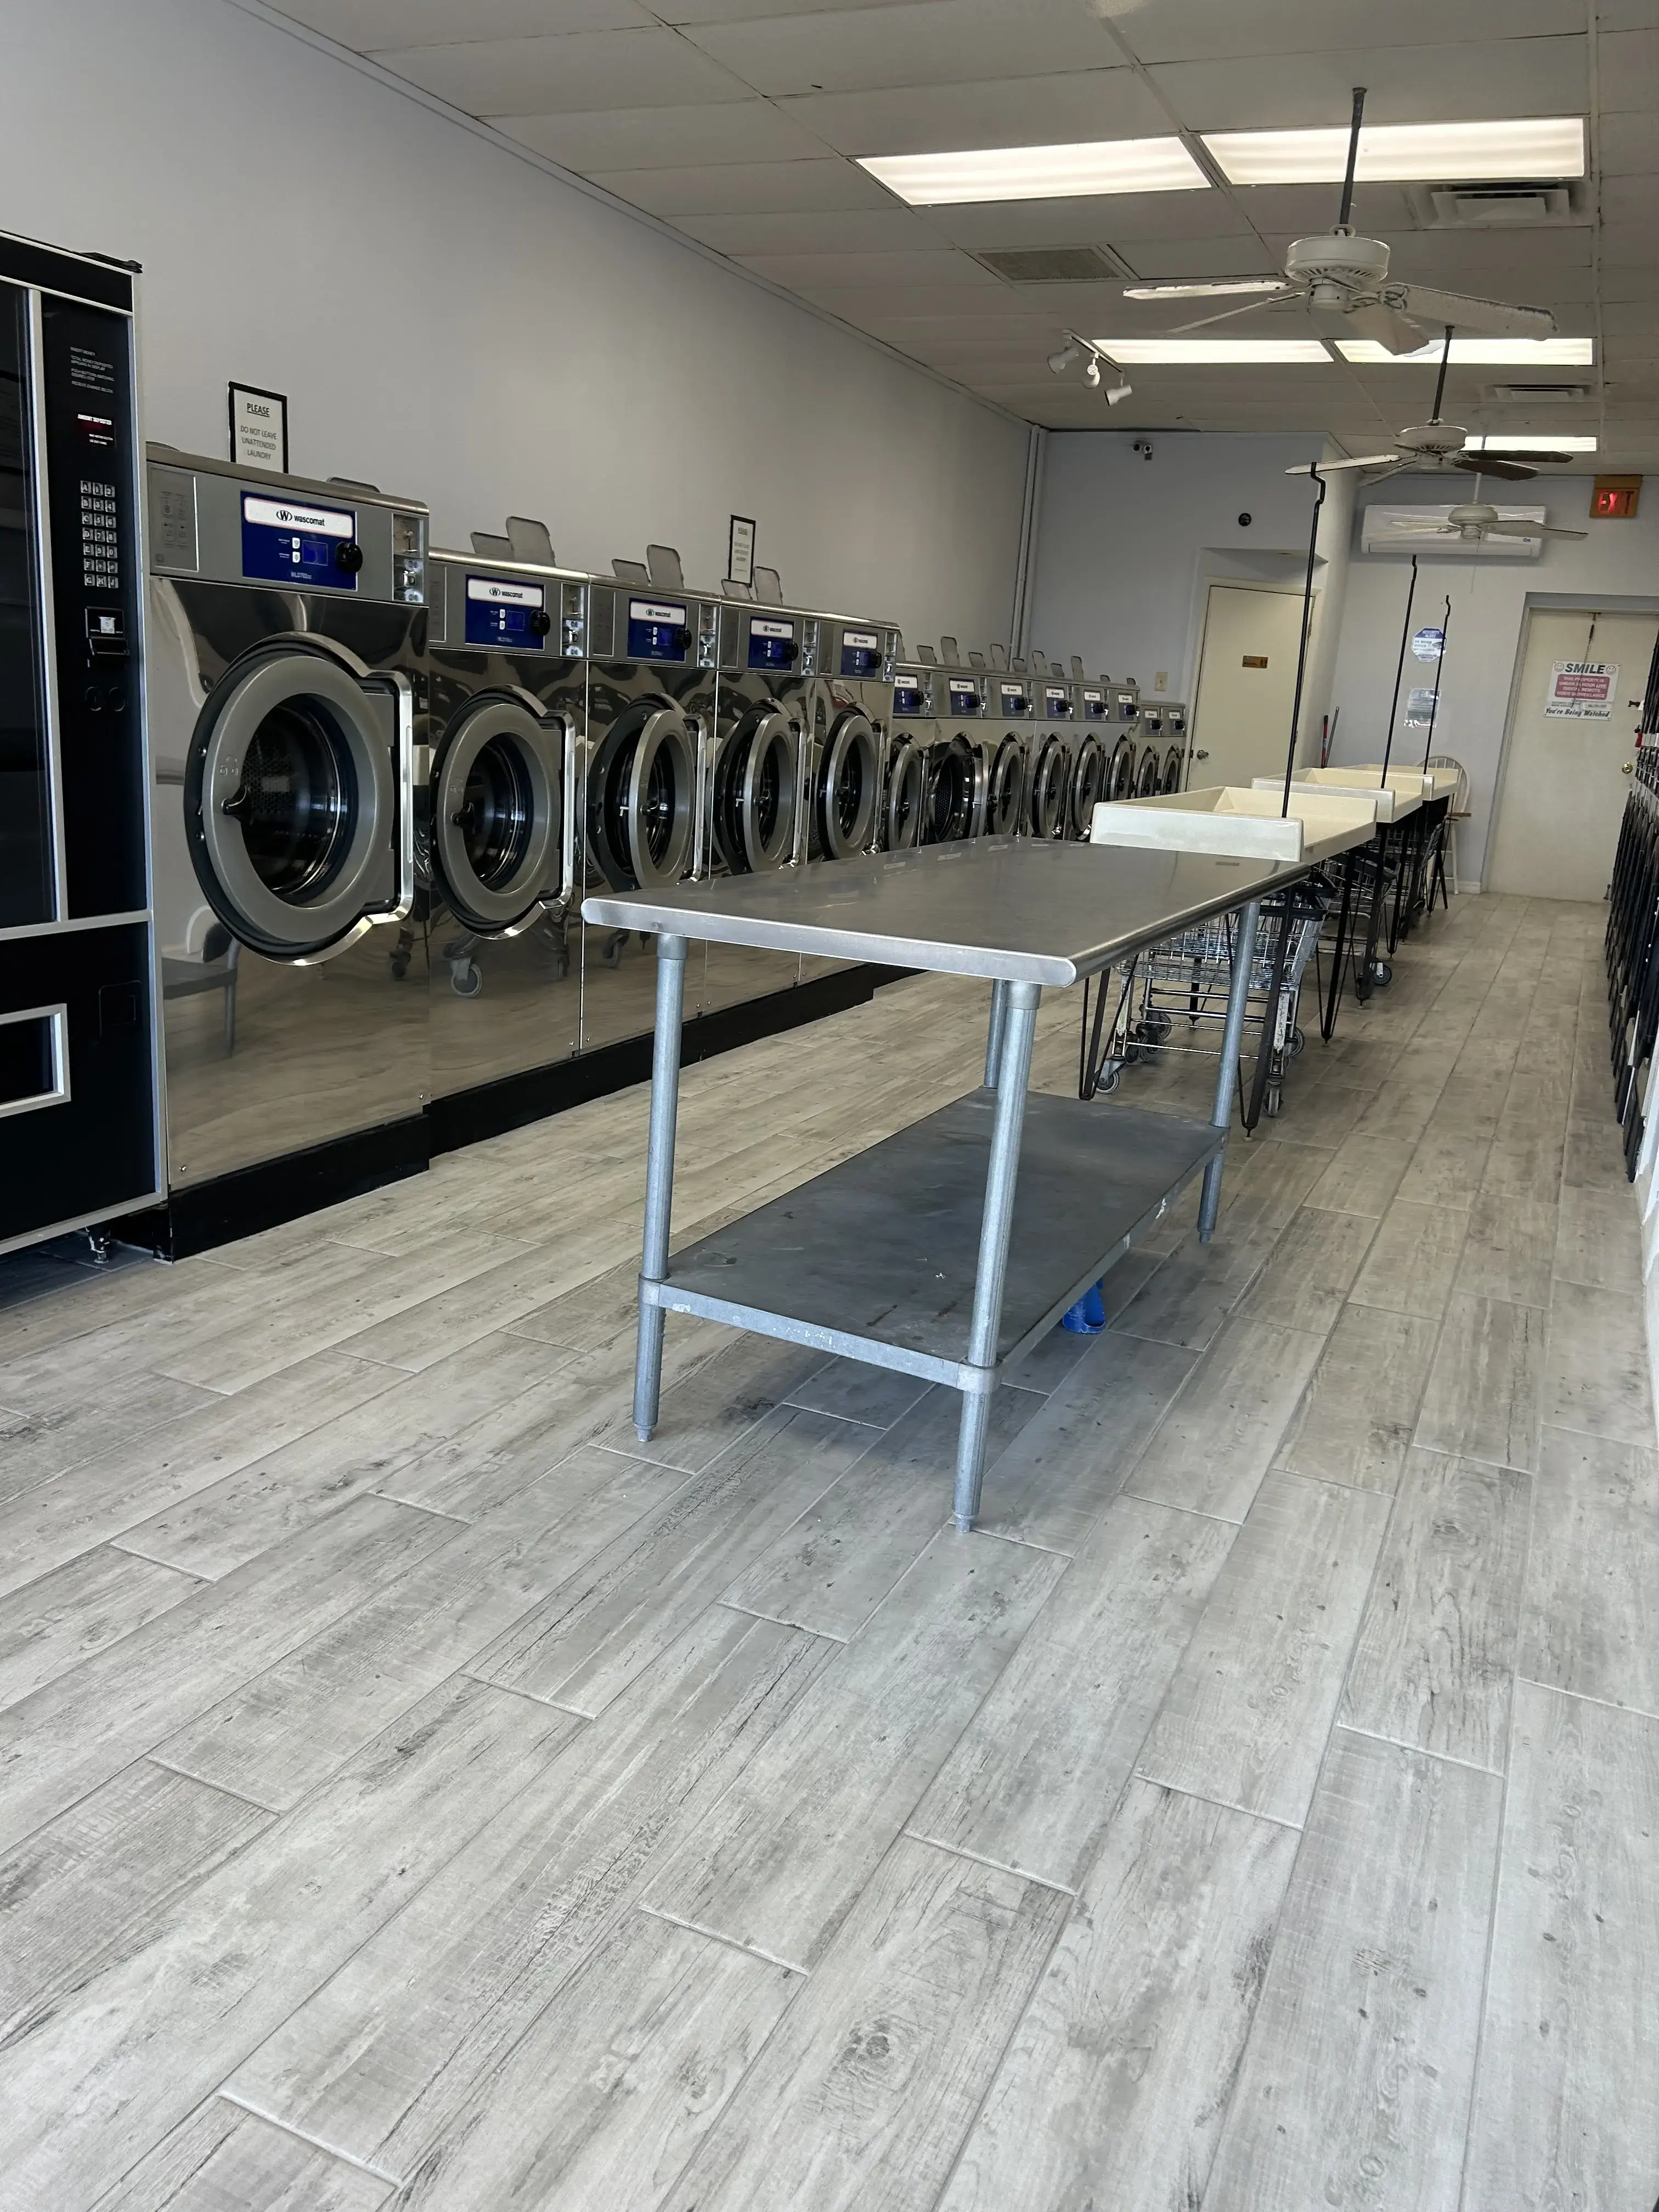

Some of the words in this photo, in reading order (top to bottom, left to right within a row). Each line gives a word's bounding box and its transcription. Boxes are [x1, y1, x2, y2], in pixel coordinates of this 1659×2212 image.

[247, 403, 270, 416] PLEASE
[240, 425, 249, 433] DO
[250, 427, 260, 436] NOT
[262, 430, 277, 439] LEAVE
[241, 437, 276, 450] UNATTENDED
[1597, 490, 1634, 514] EXIT
[294, 515, 325, 527] wascomat
[1565, 663, 1605, 674] SMILE
[1565, 709, 1582, 717] Being
